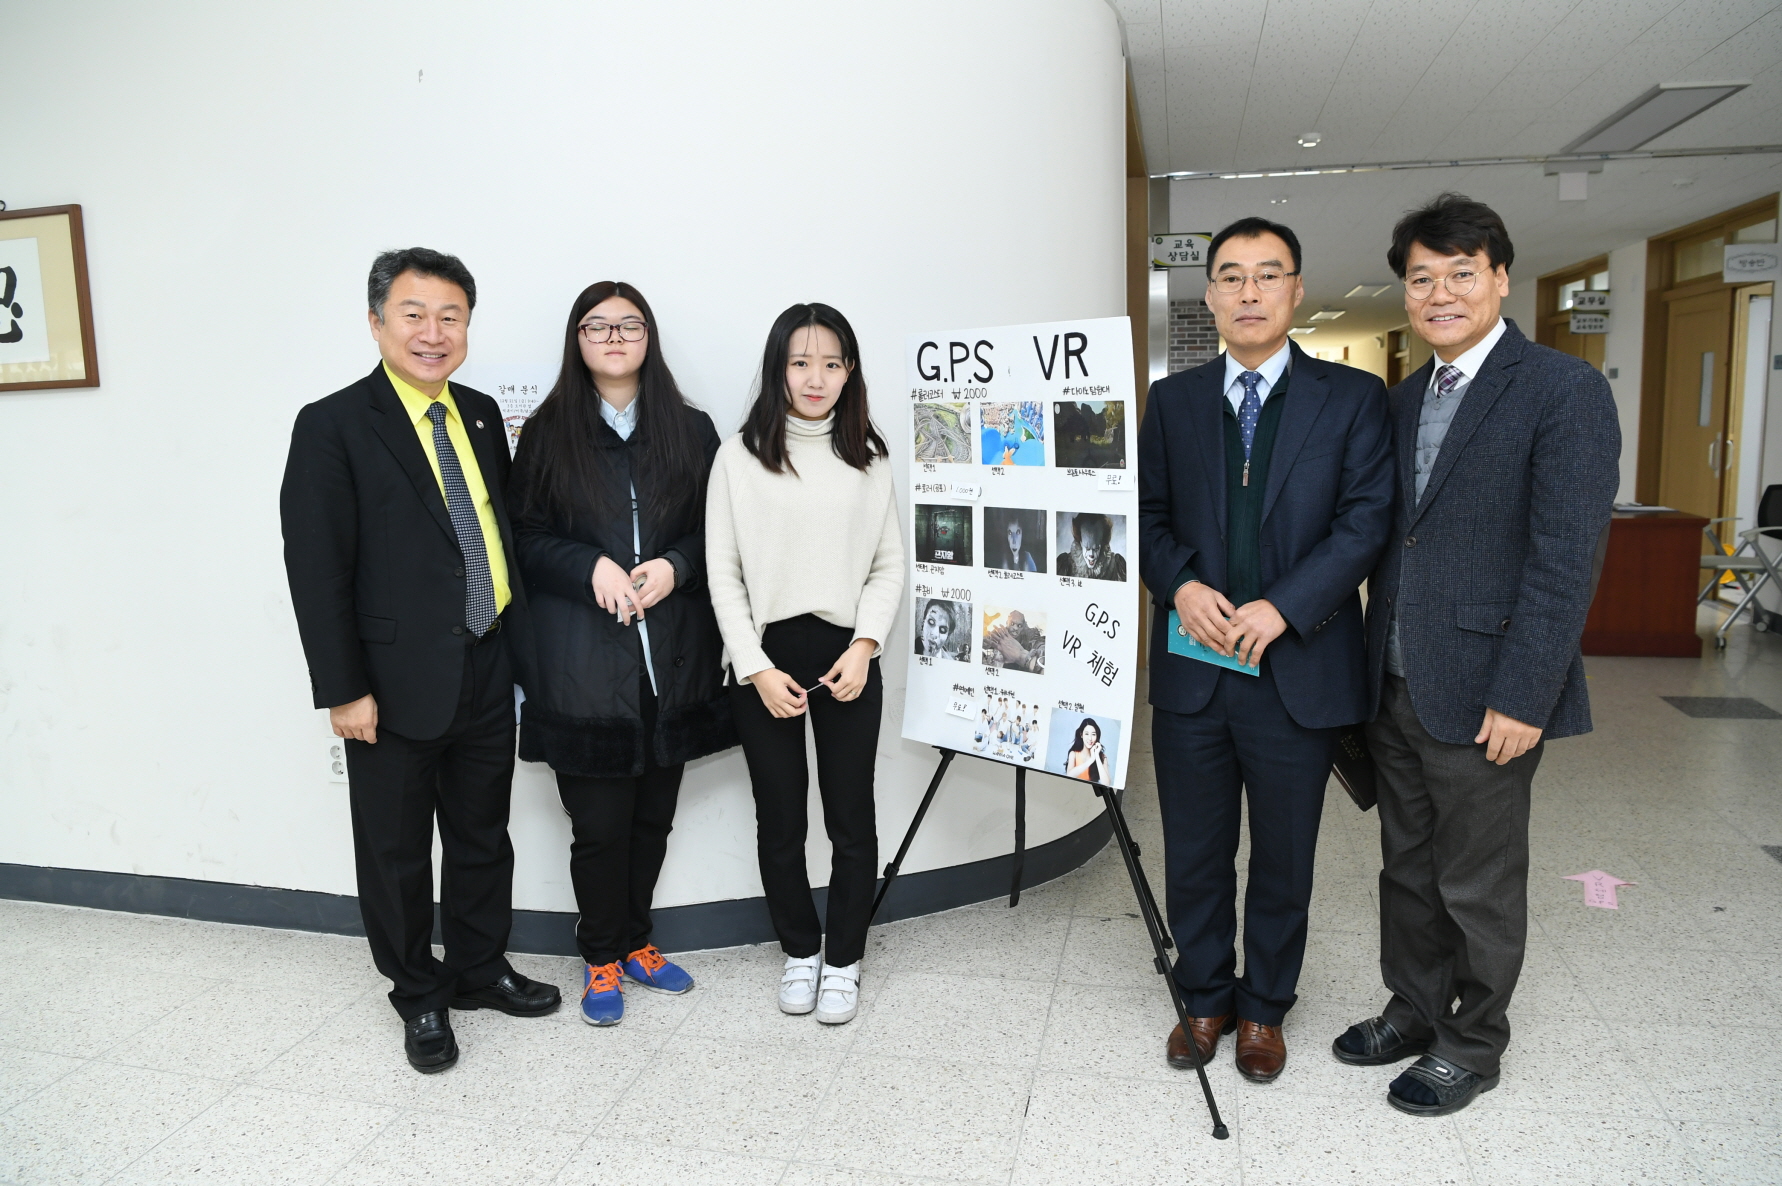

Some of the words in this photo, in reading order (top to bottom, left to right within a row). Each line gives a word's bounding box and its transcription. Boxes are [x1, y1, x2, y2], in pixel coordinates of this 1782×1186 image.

[1173, 239, 1194, 249] 교육
[1168, 250, 1199, 262] 상담실
[916, 340, 994, 383] G.P.S
[1032, 332, 1089, 381] VR
[520, 385, 538, 395] 분식
[934, 549, 954, 561] 곤지암
[1085, 602, 1120, 639] G.P.S
[1062, 630, 1082, 658] VR
[1086, 650, 1119, 687] 체험
